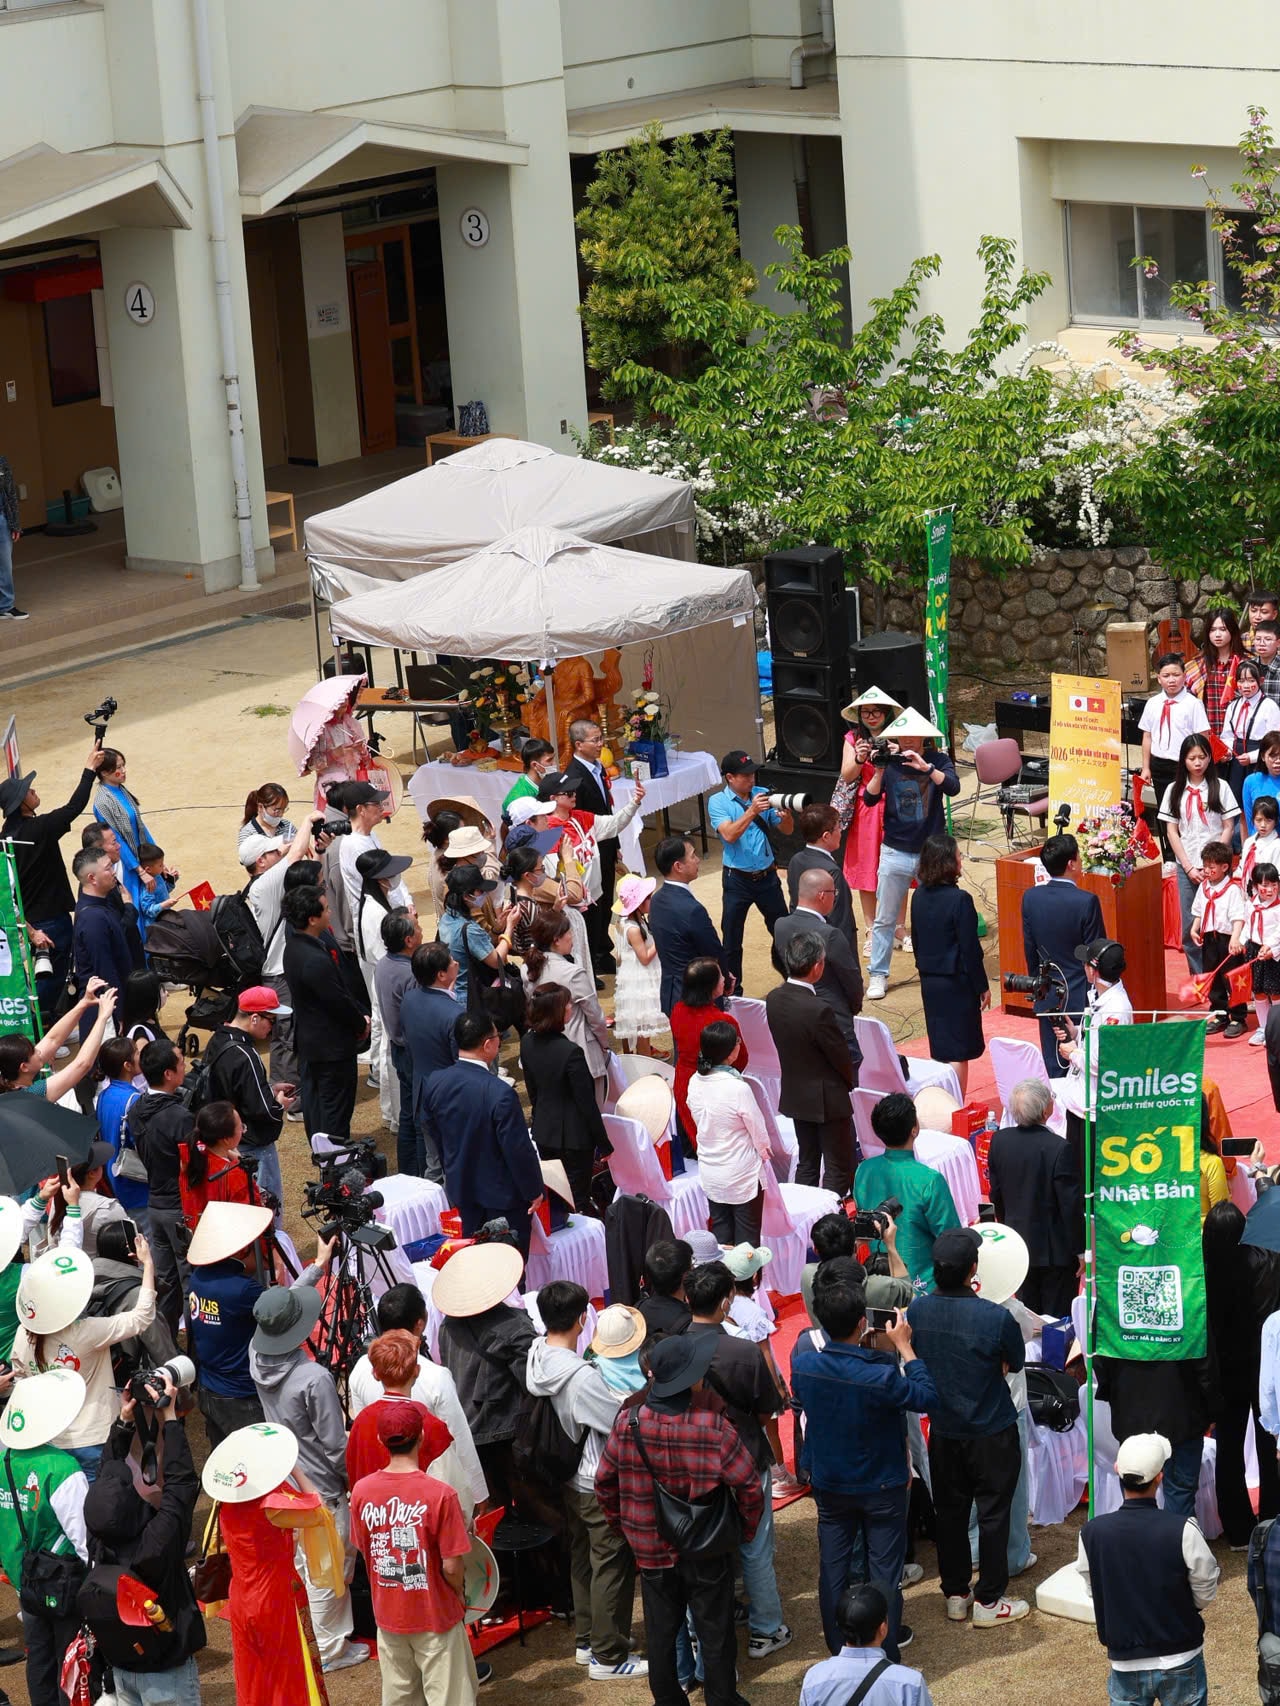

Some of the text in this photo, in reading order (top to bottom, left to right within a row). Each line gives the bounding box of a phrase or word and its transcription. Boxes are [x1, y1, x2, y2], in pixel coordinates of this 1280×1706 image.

[467, 214, 483, 242] 3
[130, 288, 148, 319] 4
[1101, 1067, 1198, 1099] Smiles
[1156, 1097, 1181, 1109] QUỐC
[1183, 1096, 1196, 1106] TẾ
[1101, 1126, 1195, 1177] Số 1
[1100, 1180, 1195, 1206] Nhật Bản
[200, 1297, 219, 1314] VJS
[361, 1496, 427, 1531] Ben Davis
[370, 1540, 387, 1549] AND
